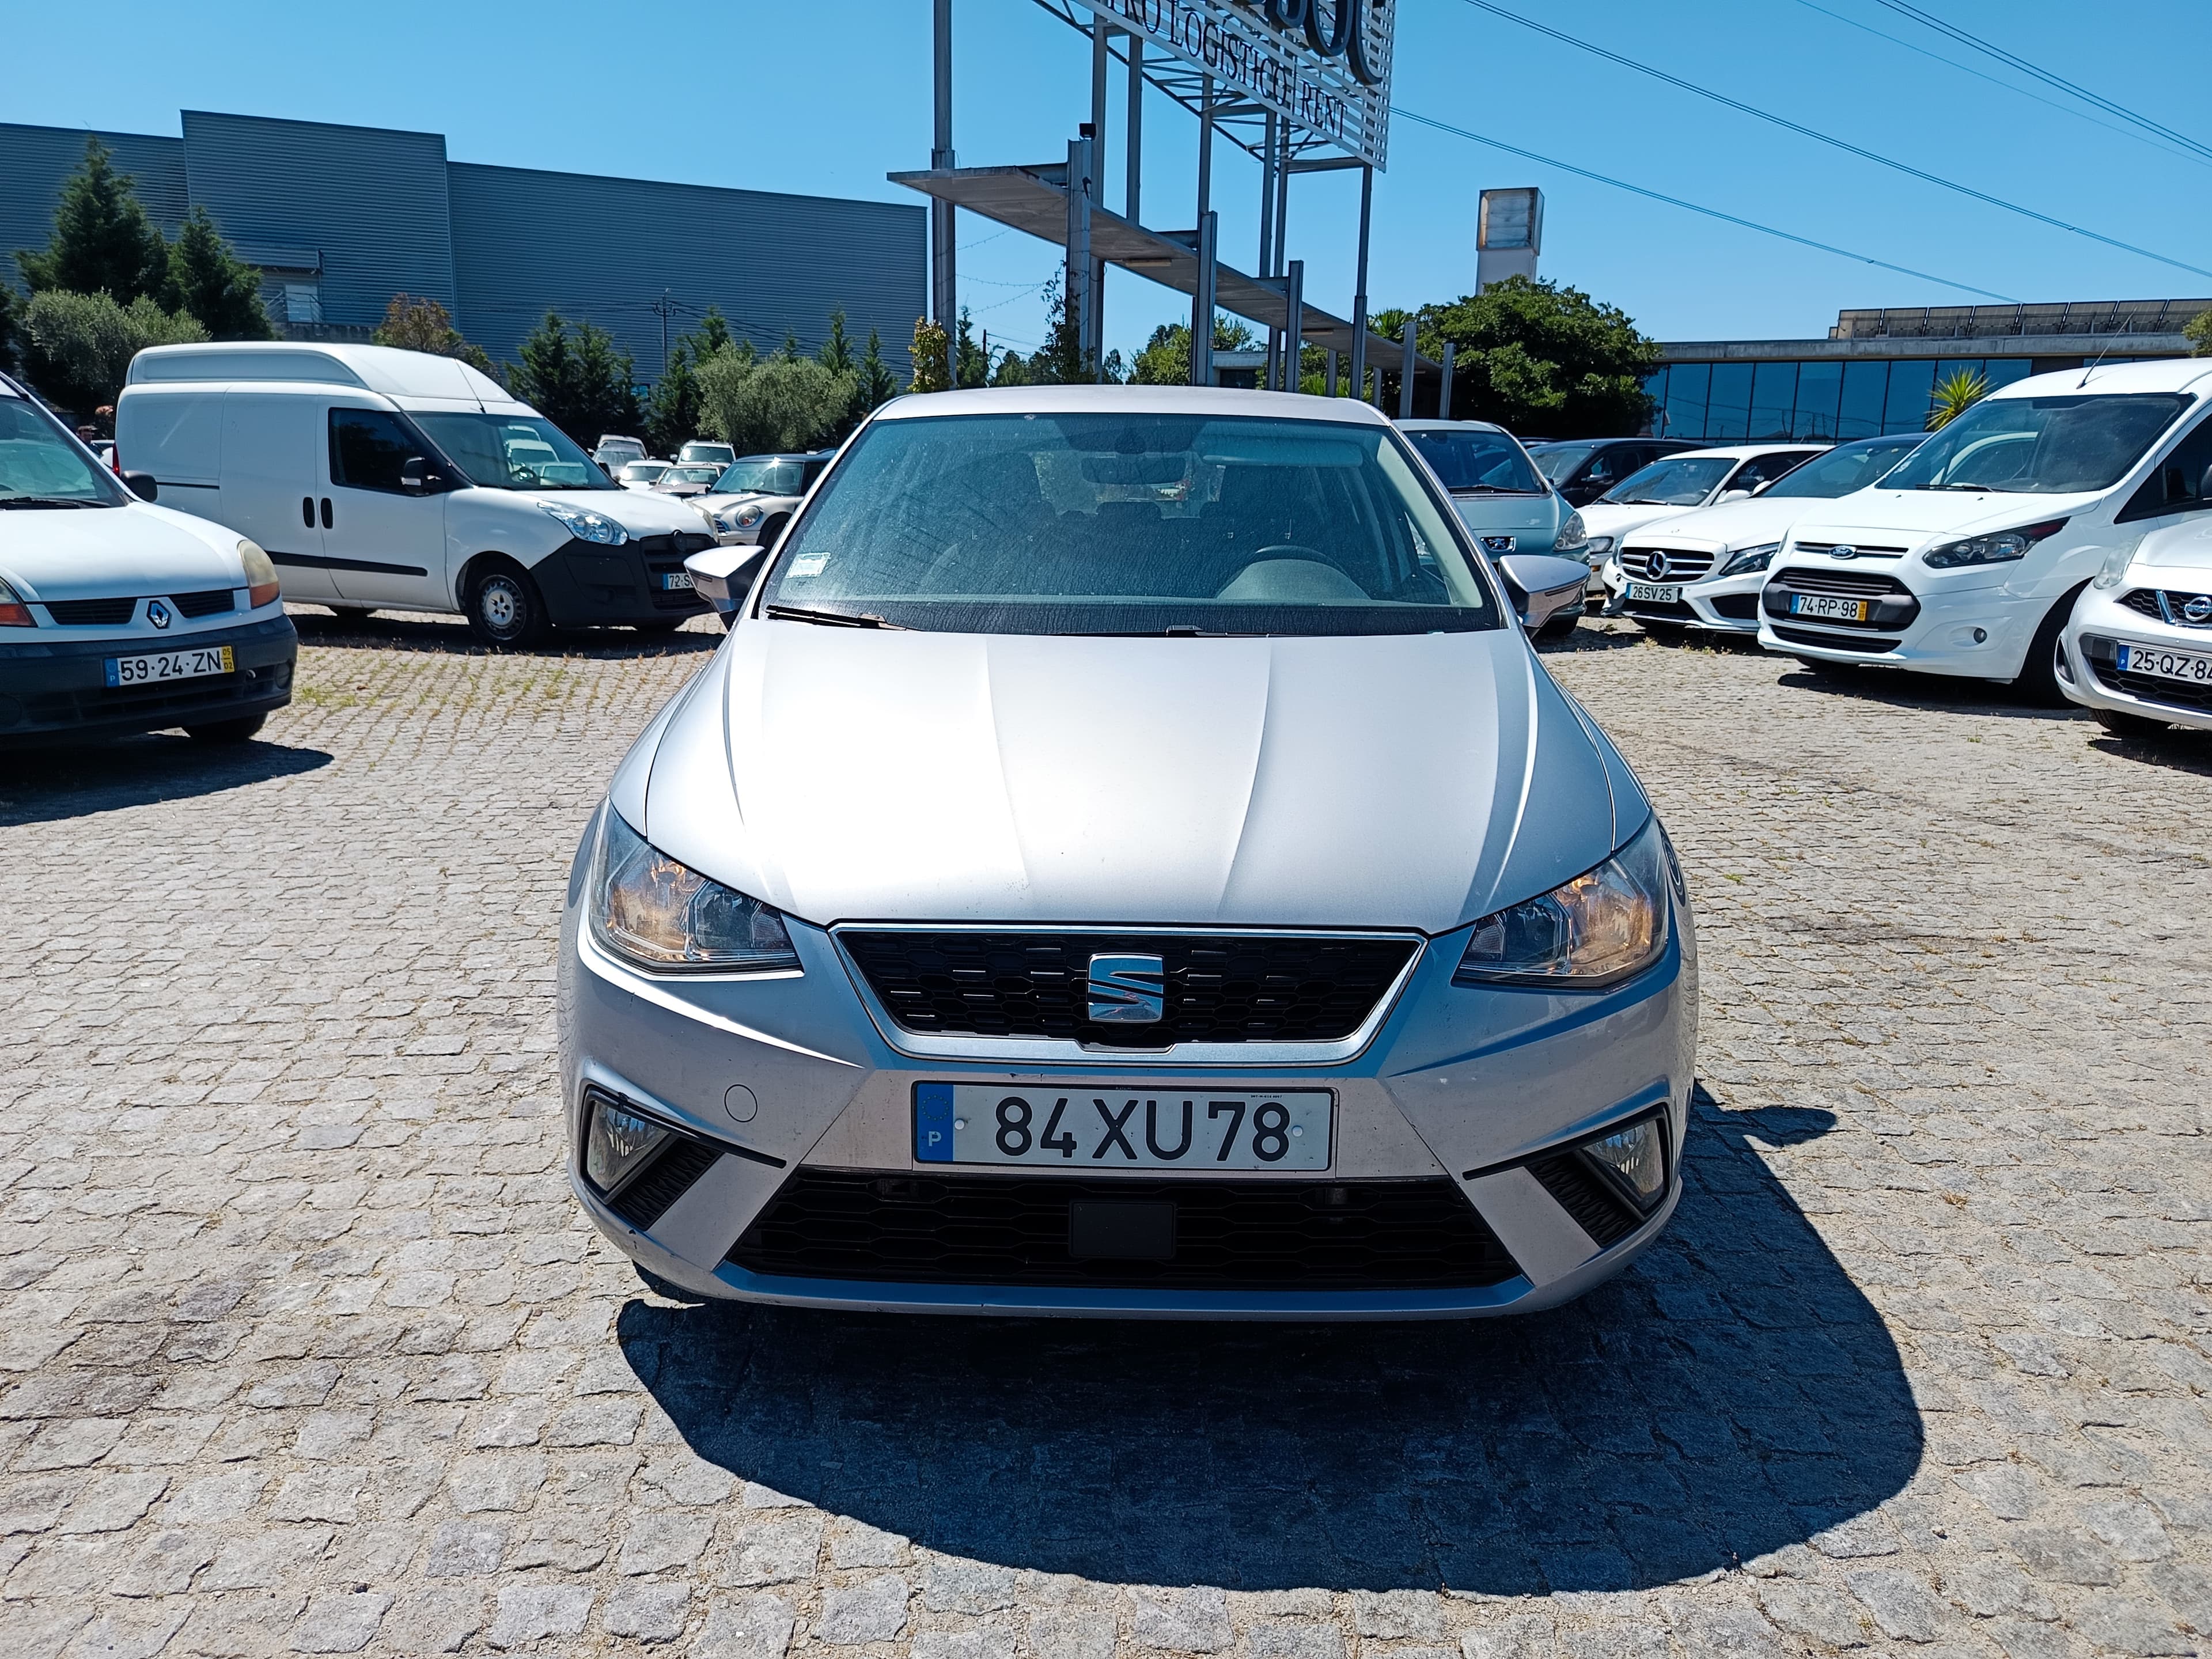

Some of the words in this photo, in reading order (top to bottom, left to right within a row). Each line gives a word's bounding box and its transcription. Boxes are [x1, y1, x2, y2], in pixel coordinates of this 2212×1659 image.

[1300, 79, 1347, 139] RENT
[222, 648, 231, 656] 05
[224, 662, 233, 670] 02
[928, 1131, 942, 1147] P
